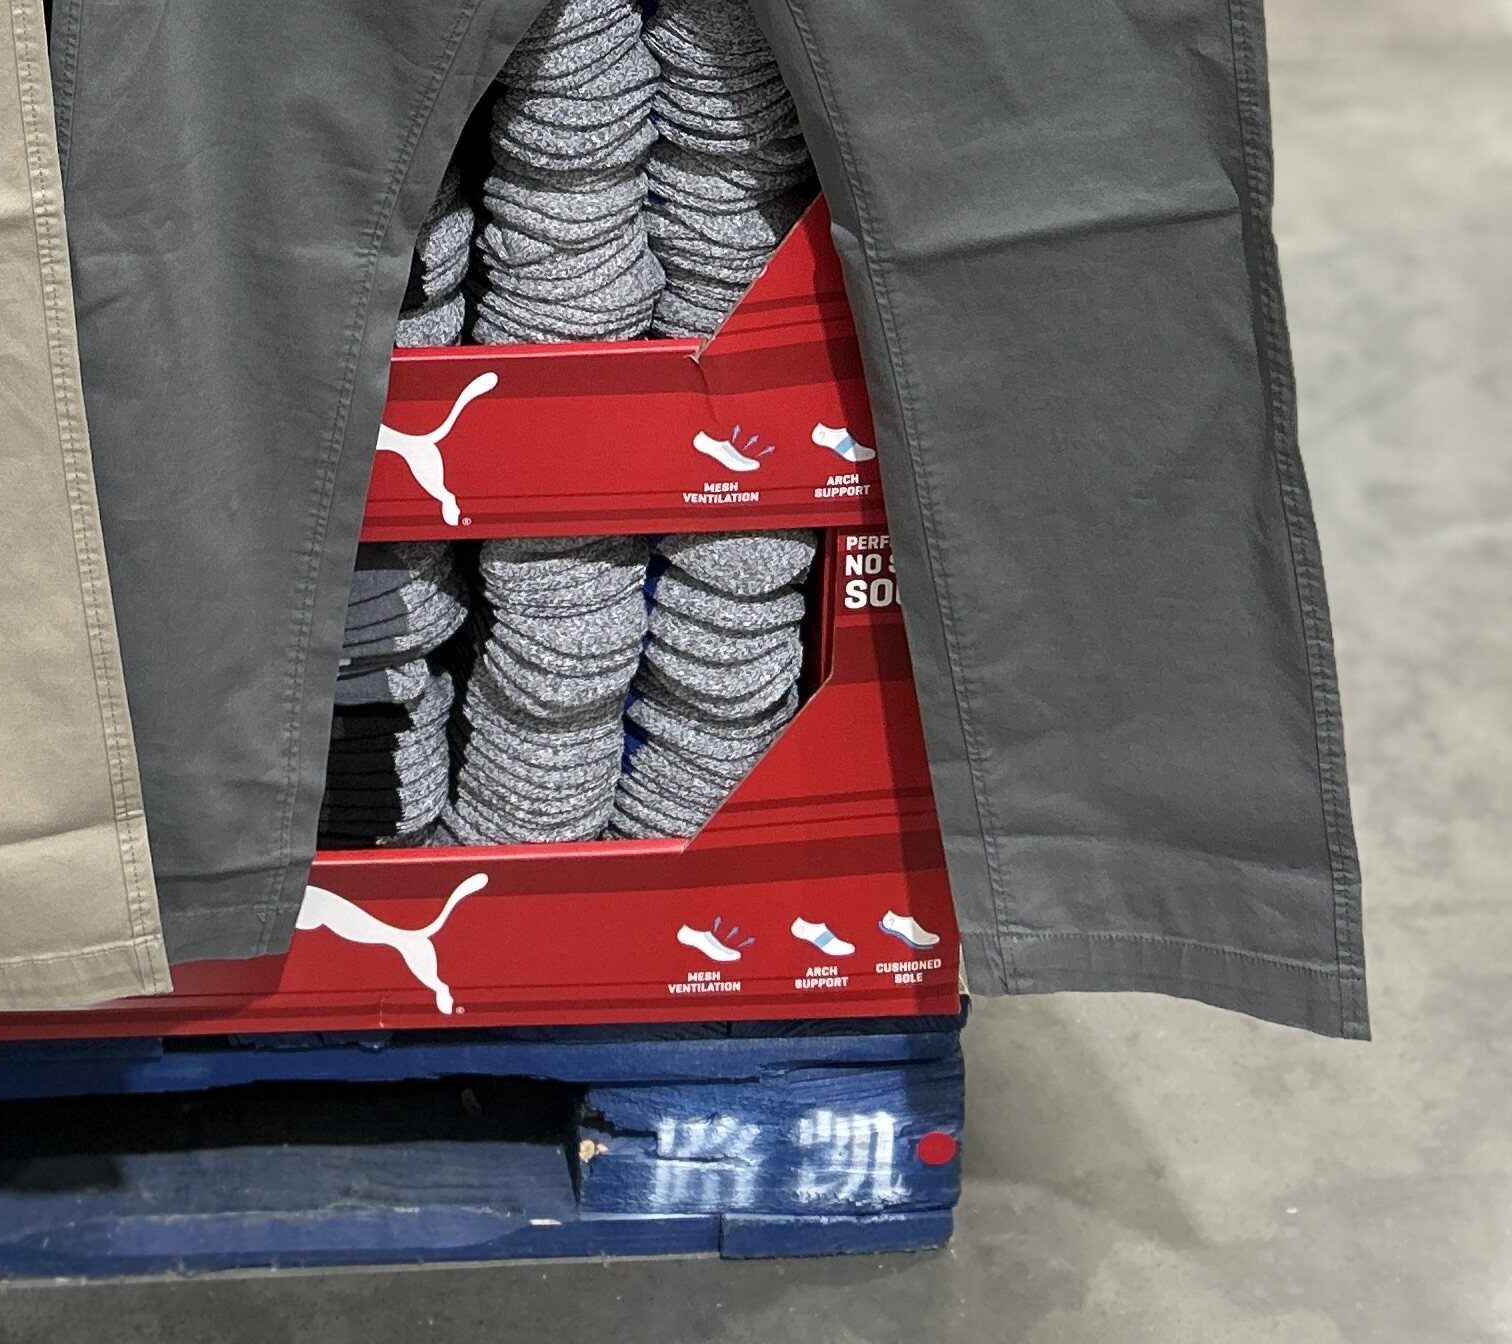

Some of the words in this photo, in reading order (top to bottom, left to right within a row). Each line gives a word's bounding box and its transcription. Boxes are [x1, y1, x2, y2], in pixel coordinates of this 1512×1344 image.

[827, 474, 859, 486] ARCH
[704, 482, 738, 493] MESH
[814, 484, 871, 499] SUPPORT
[683, 492, 759, 504] VENTILATION
[845, 553, 882, 576] NO
[806, 966, 838, 978] ARCH
[875, 958, 942, 974] CUSHIONED
[688, 971, 721, 982] MESH
[795, 976, 849, 990] SUPPORT
[894, 972, 923, 985] SOLE
[667, 981, 741, 994] VENTILATION
